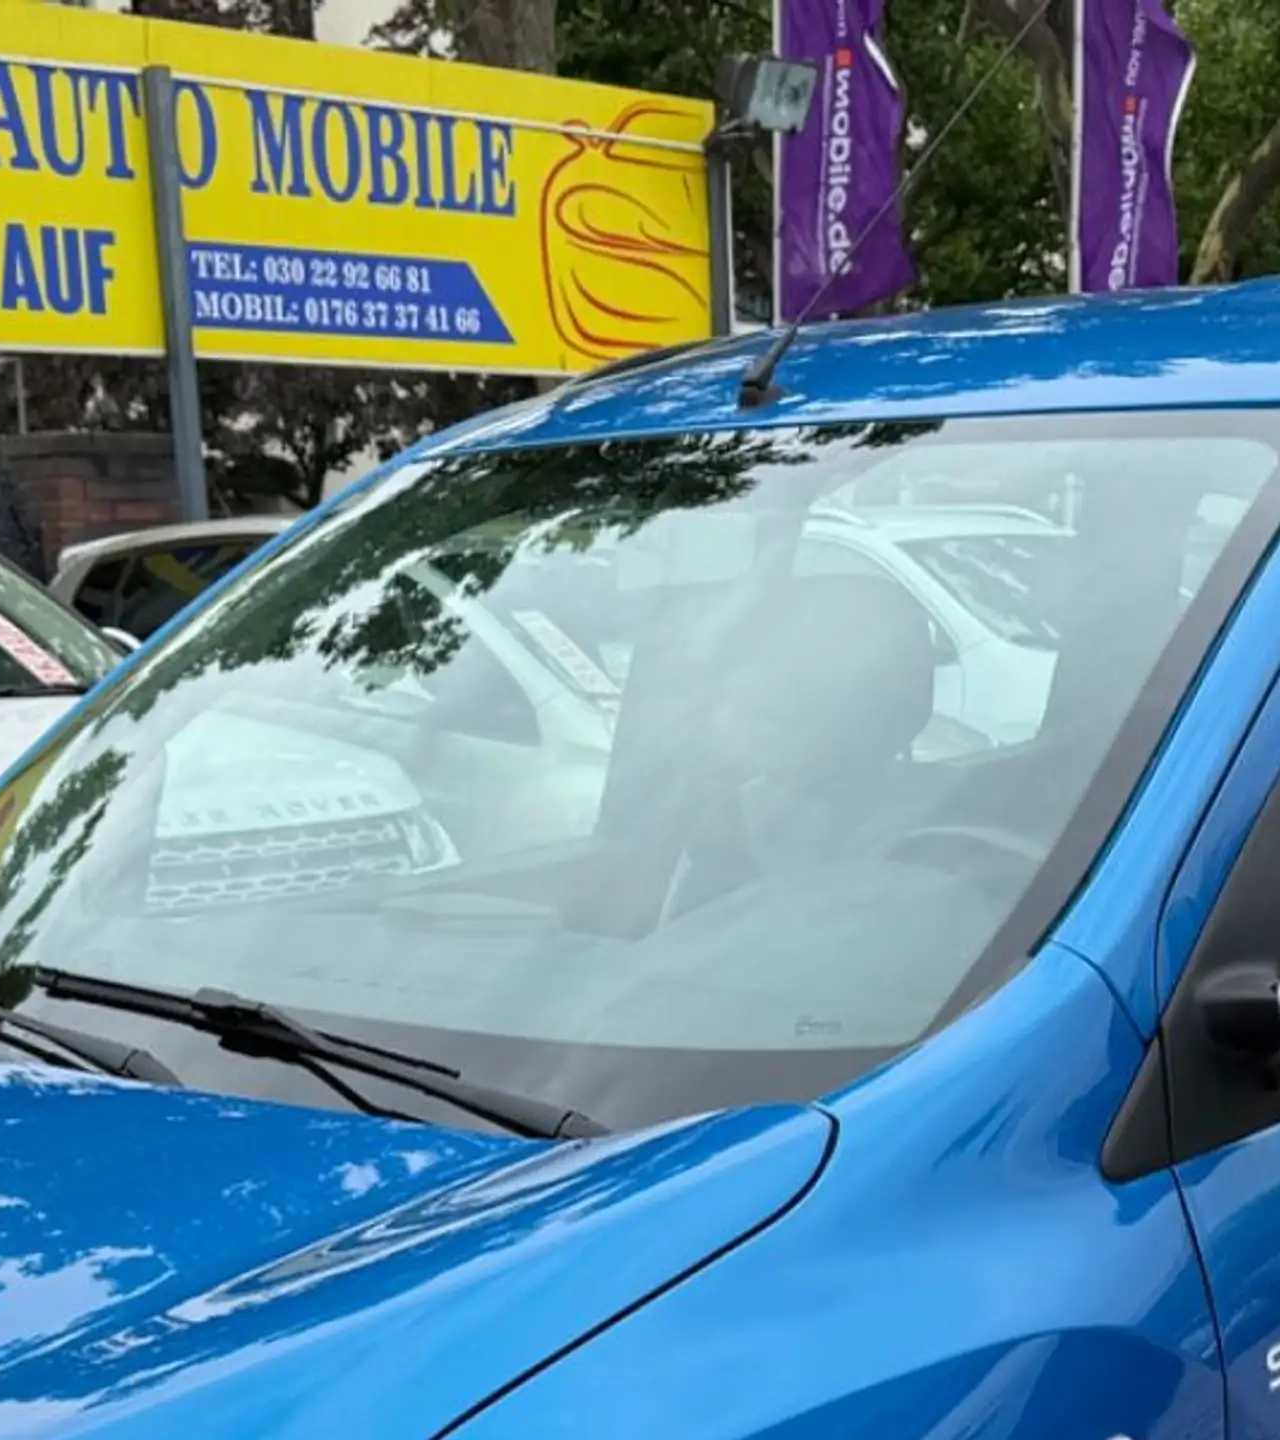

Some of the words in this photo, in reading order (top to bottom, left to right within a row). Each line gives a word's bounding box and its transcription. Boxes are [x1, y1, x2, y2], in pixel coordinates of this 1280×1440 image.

[244, 88, 516, 218] MOBILE
[826, 69, 852, 275] mobile.de
[191, 250, 258, 282] TEL:
[263, 255, 305, 286] 030
[309, 258, 338, 289] 22
[341, 261, 370, 290] 92
[373, 263, 402, 292] 66
[405, 265, 431, 294] 81
[194, 290, 300, 324] MOBIL:
[303, 296, 360, 328] 0176
[361, 299, 390, 329] 37
[393, 302, 420, 332] 37
[423, 304, 450, 333] 41
[453, 306, 481, 335] 66
